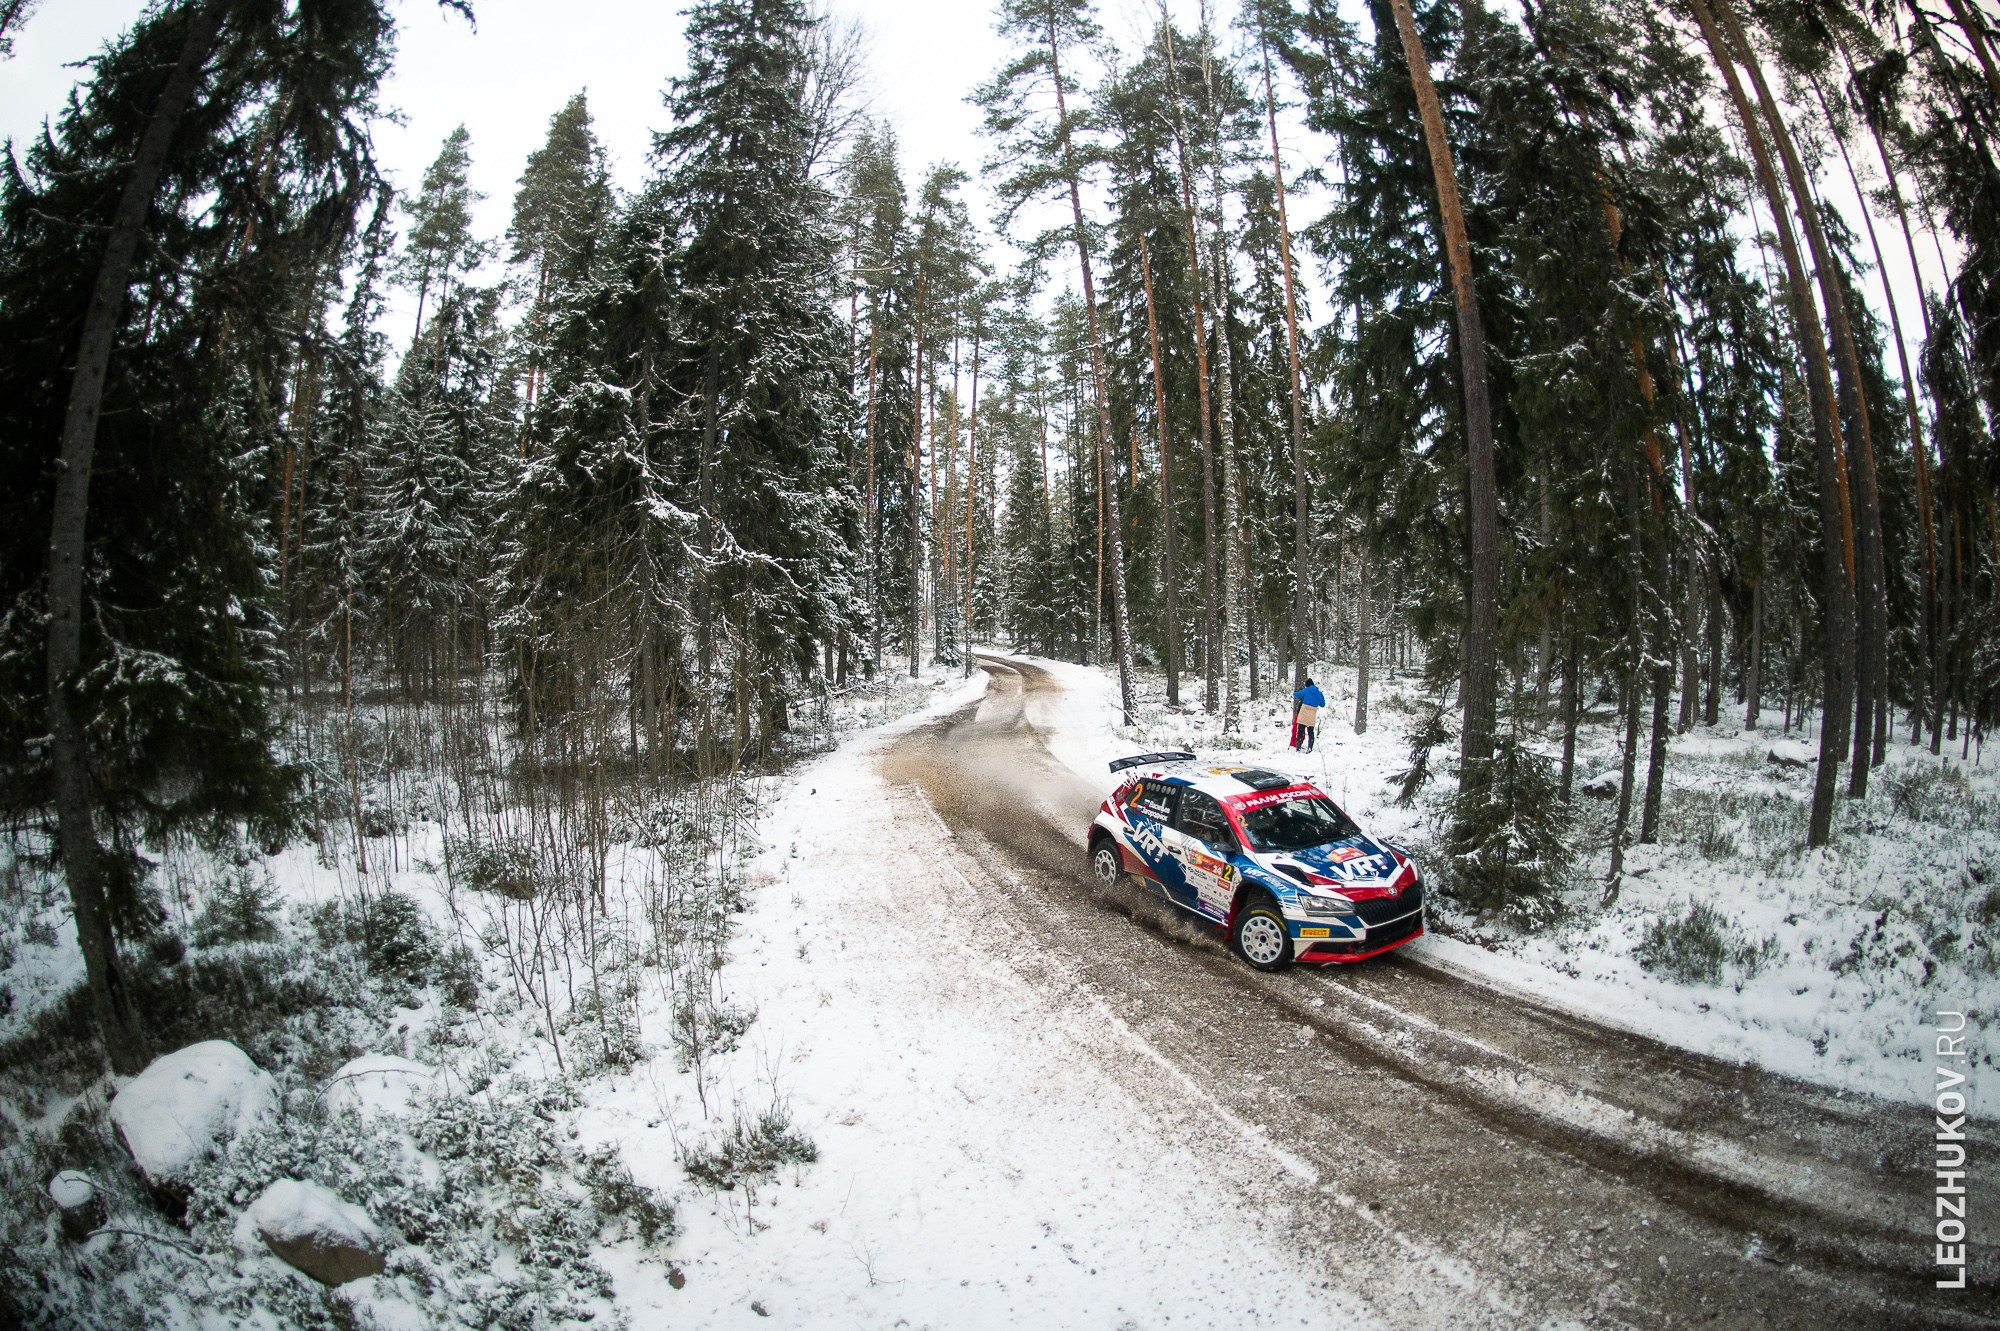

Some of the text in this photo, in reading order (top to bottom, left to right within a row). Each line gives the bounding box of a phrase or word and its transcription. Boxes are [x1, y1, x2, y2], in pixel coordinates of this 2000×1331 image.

[1130, 783, 1143, 807] 2
[1246, 795, 1279, 807] РАЛЛИ
[1237, 815, 1249, 827] 2
[1132, 820, 1170, 863] VRT
[1224, 865, 1232, 881] 2
[1329, 853, 1388, 881] VRT
